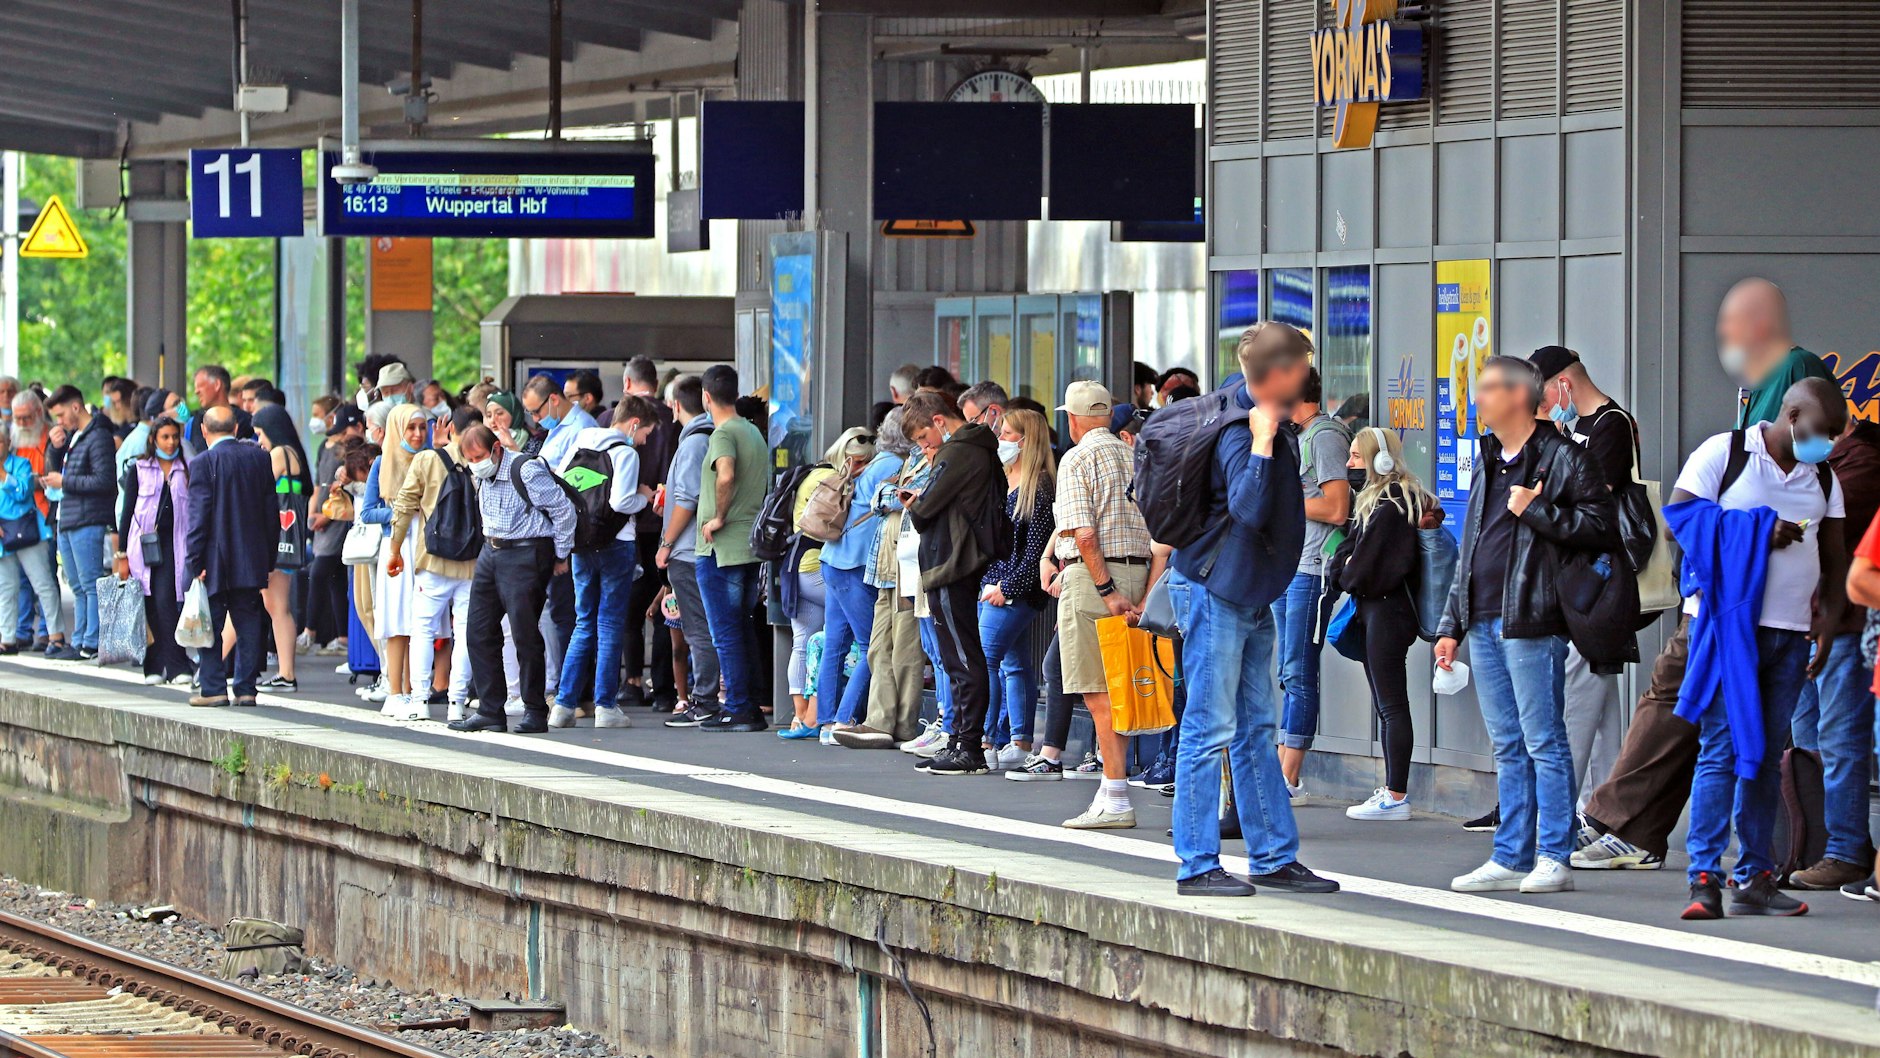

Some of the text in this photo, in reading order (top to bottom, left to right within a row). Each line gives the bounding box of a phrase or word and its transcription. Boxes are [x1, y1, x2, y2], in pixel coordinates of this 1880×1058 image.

[1310, 19, 1391, 107] YORMA'S
[203, 153, 262, 218] 11
[342, 184, 353, 194] RE
[356, 184, 367, 194] 49
[376, 185, 401, 195] 31920
[426, 185, 462, 195] E-Steele
[534, 186, 589, 196] W-Vohwinkel
[395, 176, 440, 185] Verbindung
[343, 195, 547, 217] 16:13 Wuppertal Hbf
[1388, 397, 1425, 431] YORMA'S
[277, 541, 295, 554] en
